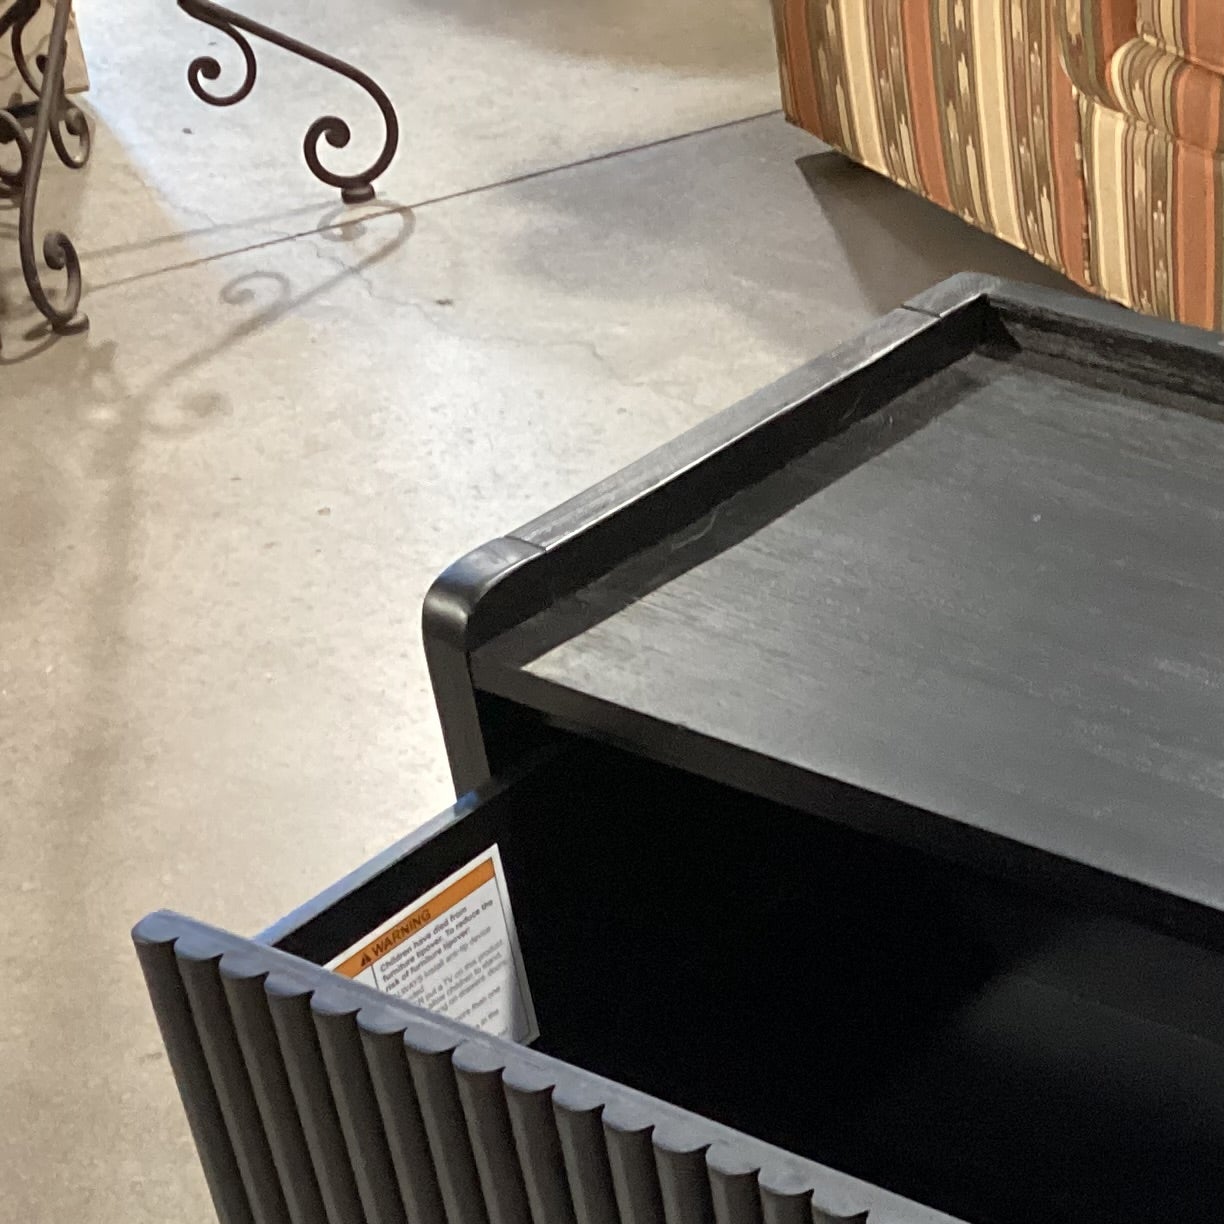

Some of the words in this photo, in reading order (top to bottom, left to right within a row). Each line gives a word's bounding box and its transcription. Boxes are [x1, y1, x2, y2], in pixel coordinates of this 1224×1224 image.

[371, 908, 432, 958] WARNING
[380, 946, 413, 972] Children
[413, 932, 432, 949] have
[432, 917, 449, 935] died
[450, 906, 468, 922] from
[382, 956, 416, 982] furniture
[445, 927, 455, 937] To
[455, 908, 480, 930] reduce
[481, 899, 494, 911] the
[385, 979, 400, 992] risk
[401, 969, 410, 981] of
[410, 948, 443, 974] furniture
[443, 974, 453, 986] TV
